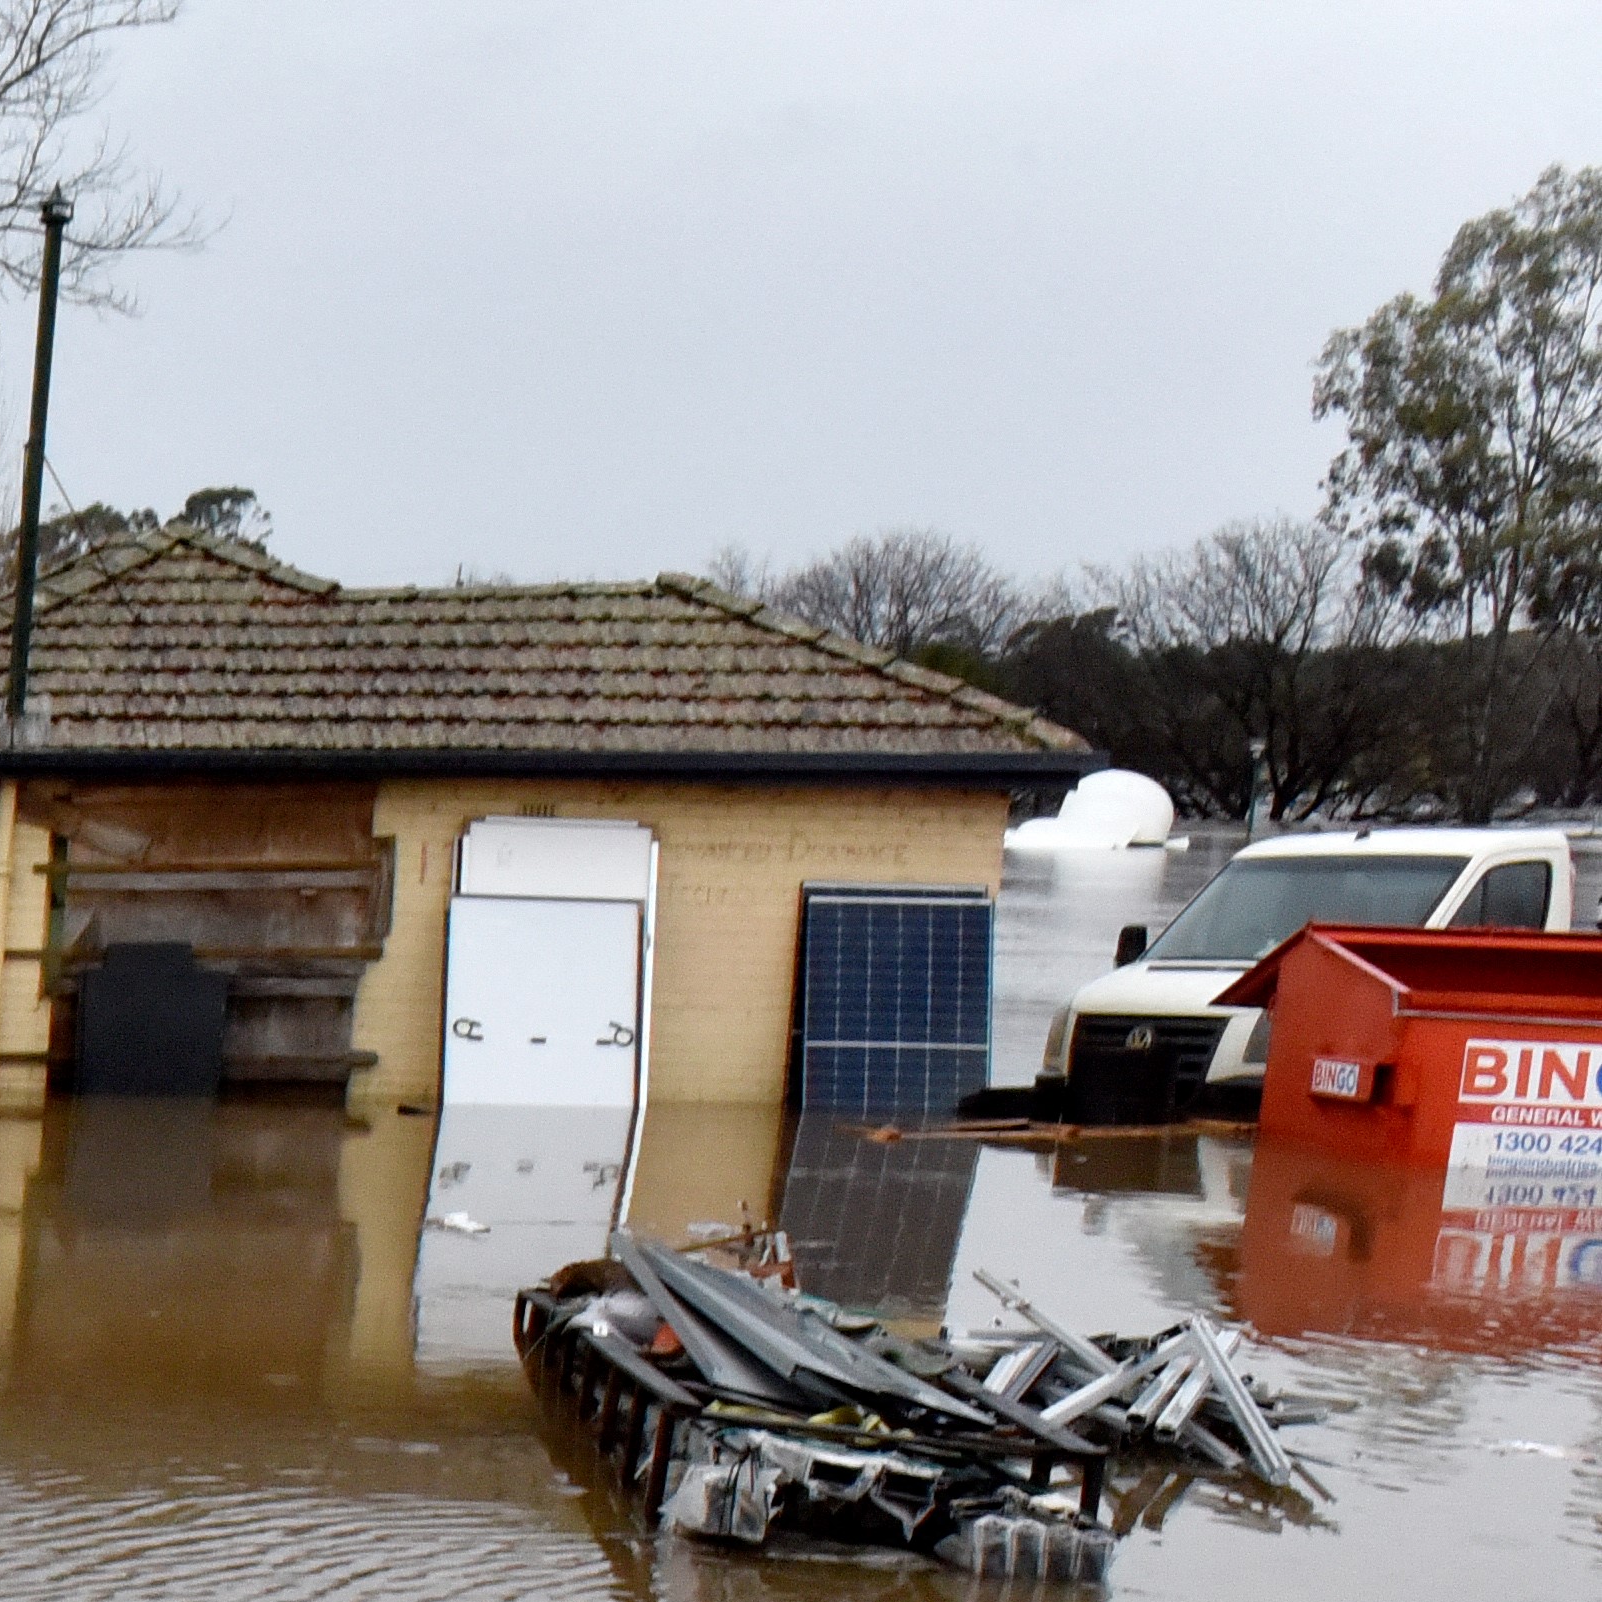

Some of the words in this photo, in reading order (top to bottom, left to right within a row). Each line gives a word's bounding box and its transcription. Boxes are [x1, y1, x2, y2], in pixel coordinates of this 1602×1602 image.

[1314, 1063, 1357, 1093] BINGO
[1462, 1046, 1602, 1101] BIN
[1491, 1105, 1585, 1127] GENERAL
[1493, 1131, 1552, 1153] 1300
